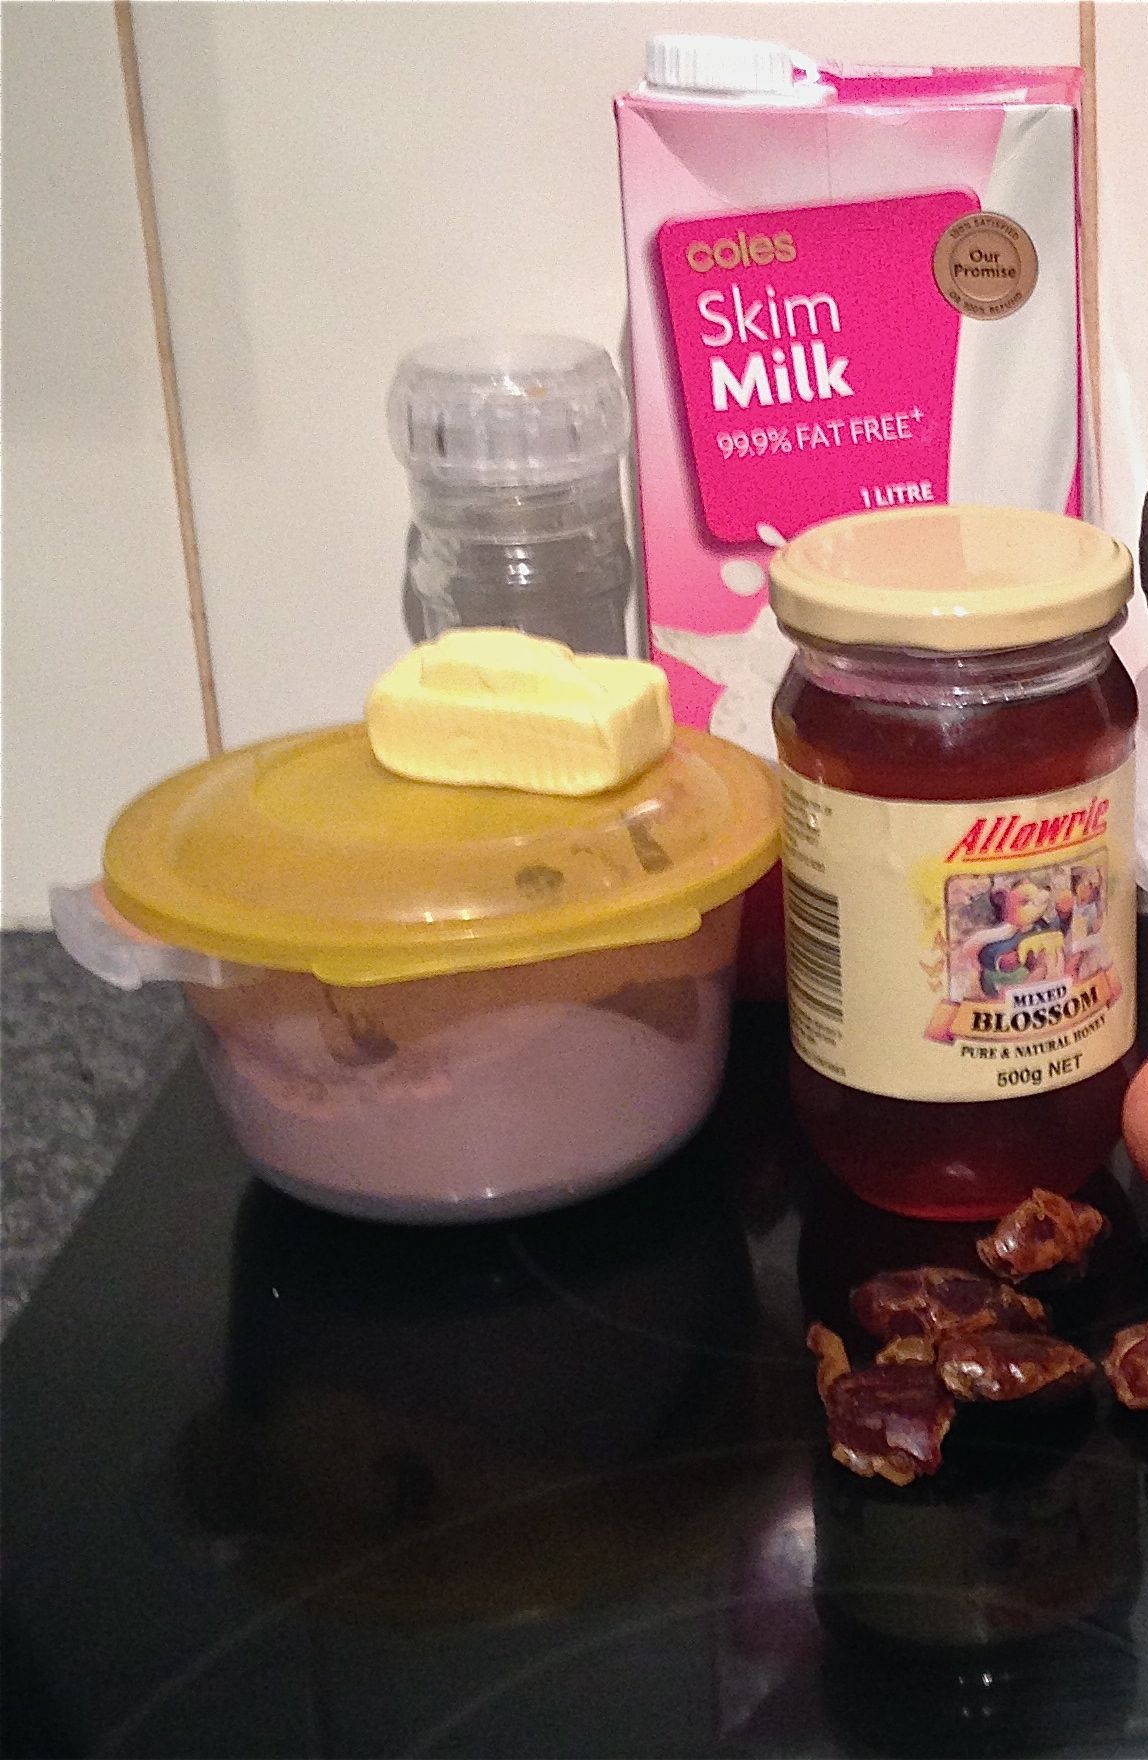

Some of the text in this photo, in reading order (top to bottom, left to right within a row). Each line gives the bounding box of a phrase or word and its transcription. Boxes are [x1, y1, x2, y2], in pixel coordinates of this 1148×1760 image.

[686, 229, 797, 273] coles
[953, 263, 1017, 279] Promise
[969, 249, 1000, 262] Our
[697, 283, 841, 347] Skim
[710, 339, 855, 411] Milk
[716, 426, 793, 459] 99.9%
[795, 419, 845, 450] FAT
[860, 480, 934, 508] 1 LITRE
[971, 986, 1099, 1033] BLOSSOM
[1013, 985, 1067, 1008] MIXED
[960, 1014, 1106, 1060] PURE & NATURAL HONEY
[997, 1053, 1083, 1087] 500g NET
